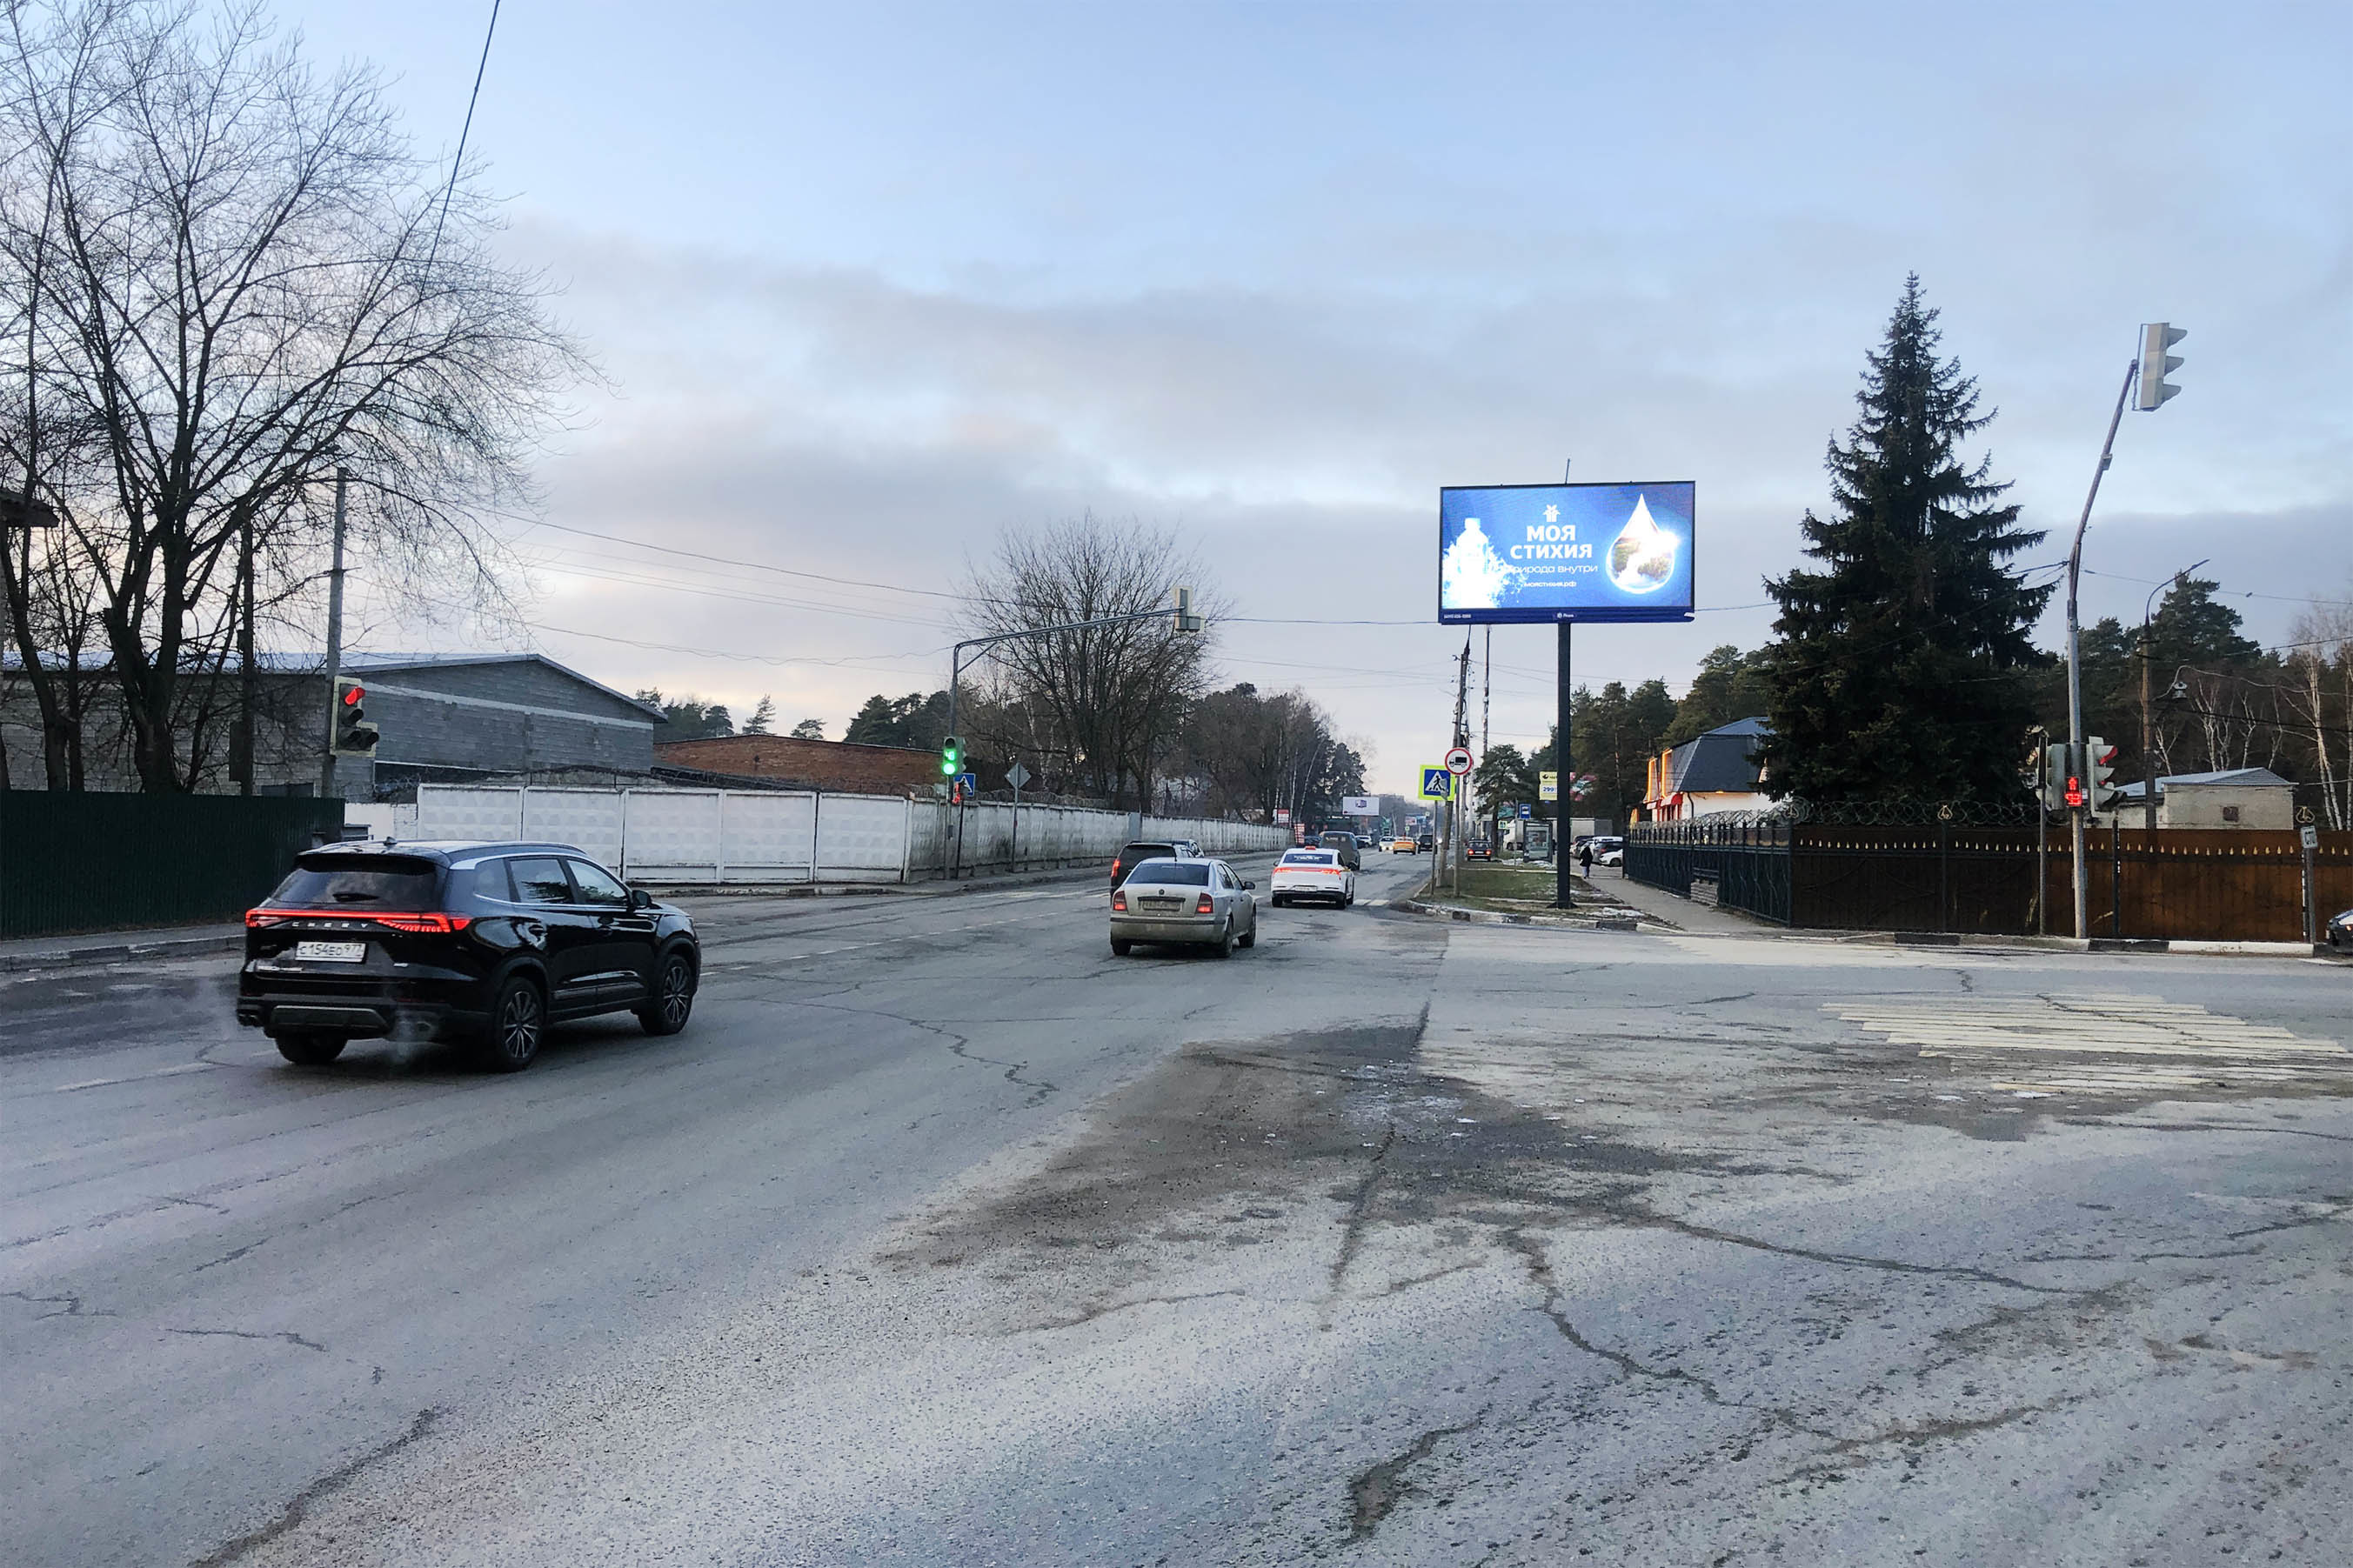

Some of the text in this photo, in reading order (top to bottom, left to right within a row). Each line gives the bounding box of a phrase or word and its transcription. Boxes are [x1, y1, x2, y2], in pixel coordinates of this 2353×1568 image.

[1527, 524, 1576, 542] МОЯ
[1509, 544, 1593, 559] СТИХИЯ
[1558, 564, 1598, 575] внутри
